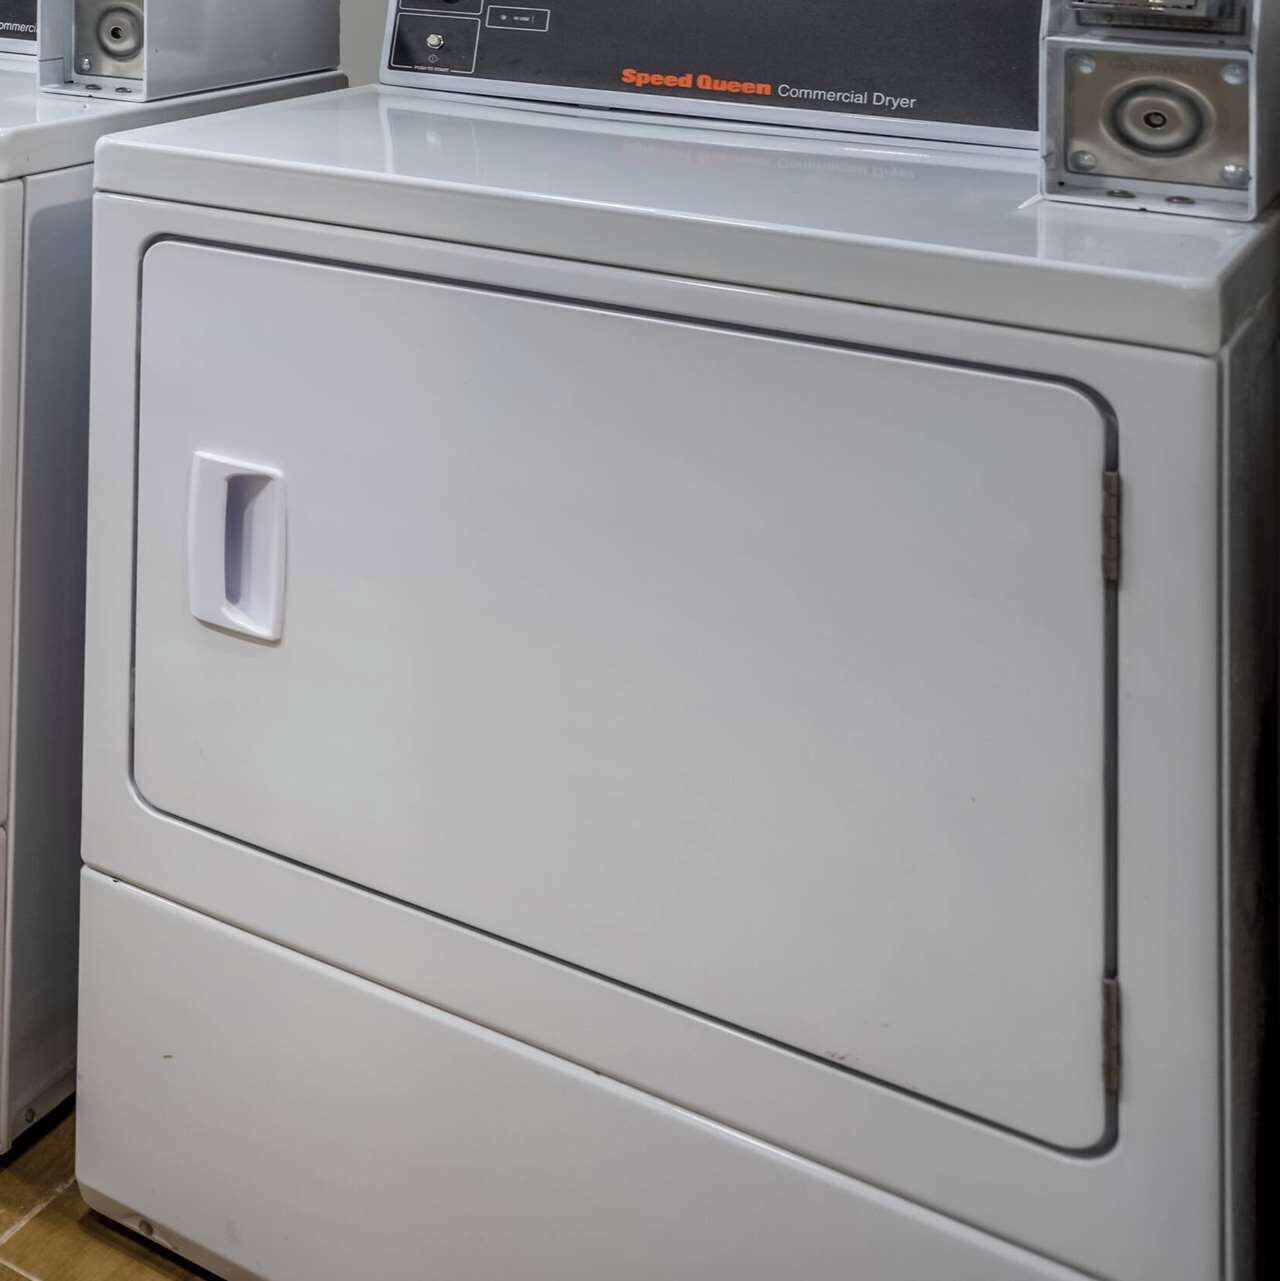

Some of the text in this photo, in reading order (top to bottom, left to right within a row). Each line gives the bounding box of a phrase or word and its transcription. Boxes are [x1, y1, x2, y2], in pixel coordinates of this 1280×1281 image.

[621, 68, 917, 110] Speed Queen Commercial Dryer
